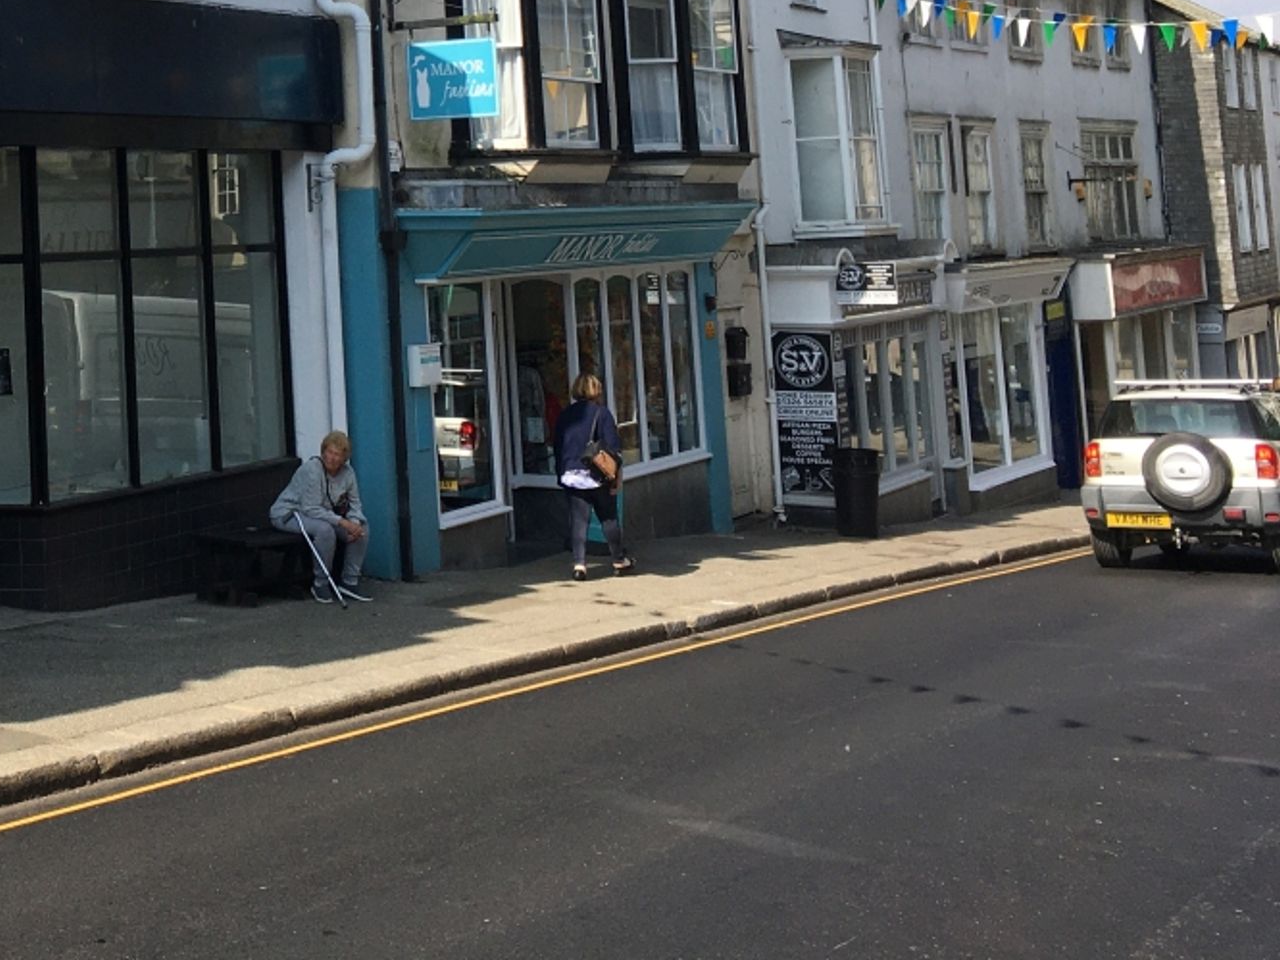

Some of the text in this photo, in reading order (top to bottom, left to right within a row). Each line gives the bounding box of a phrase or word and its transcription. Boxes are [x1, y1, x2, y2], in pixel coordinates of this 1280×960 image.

[431, 59, 485, 76] MANOR
[545, 234, 624, 262] MANOR
[780, 349, 822, 373] S&V
